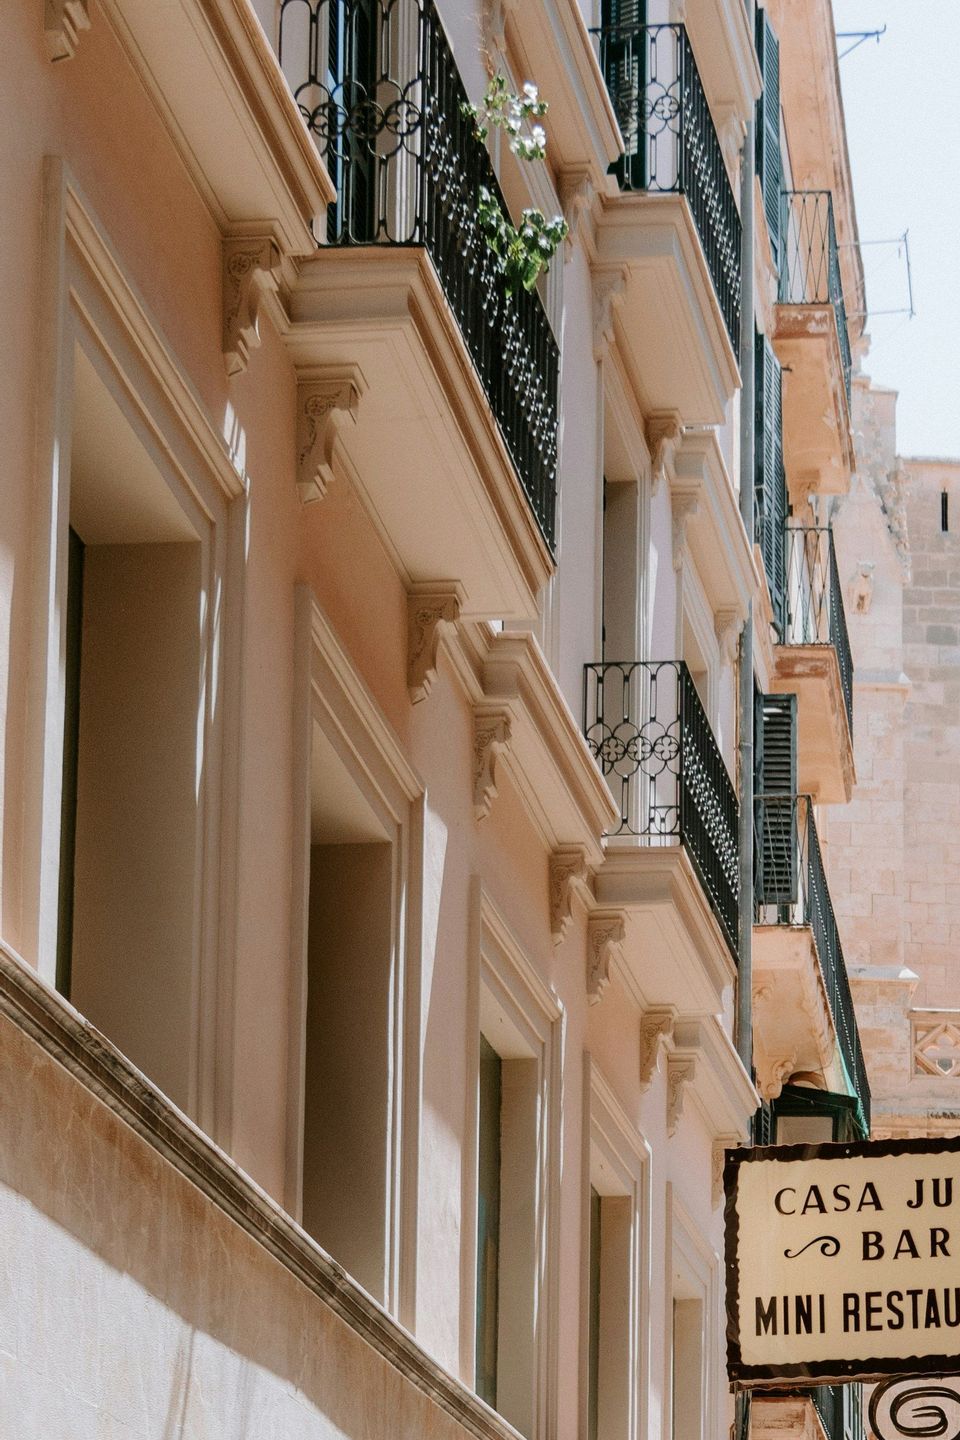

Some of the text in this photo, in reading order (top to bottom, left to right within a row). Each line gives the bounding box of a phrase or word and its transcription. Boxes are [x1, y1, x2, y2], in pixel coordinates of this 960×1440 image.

[774, 1181, 884, 1216] CASA
[861, 1227, 951, 1261] BAR
[755, 1293, 826, 1337] MINI
